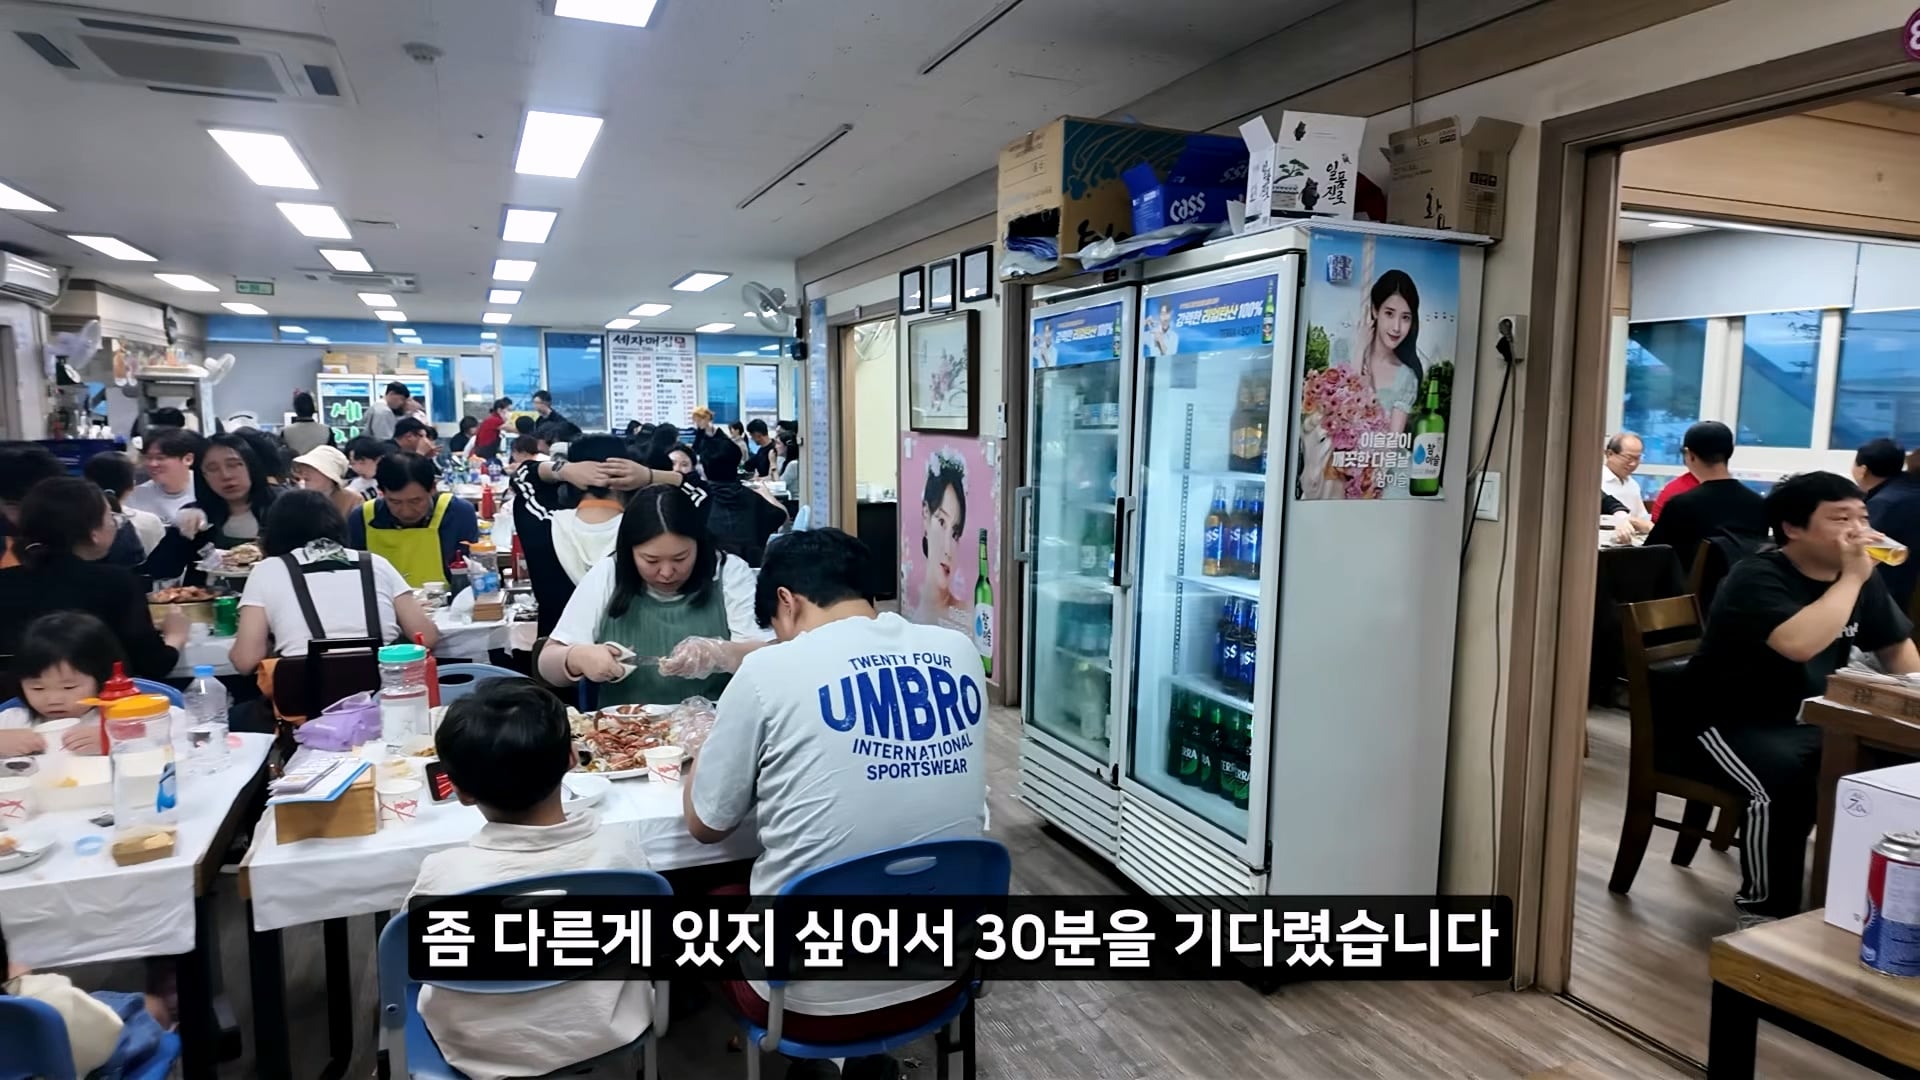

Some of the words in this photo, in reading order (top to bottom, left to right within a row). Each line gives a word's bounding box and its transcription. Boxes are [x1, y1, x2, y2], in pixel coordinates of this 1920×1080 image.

[1238, 300, 1264, 319] 100%
[1360, 432, 1412, 449] 이슬같이
[1371, 450, 1411, 468] 다음날
[848, 654, 908, 670] TWENTY
[913, 652, 952, 669] FOUR
[818, 666, 982, 742] UMBRO
[852, 733, 974, 761] INTERNATIONAL
[867, 758, 968, 781] SPORTSWEAR
